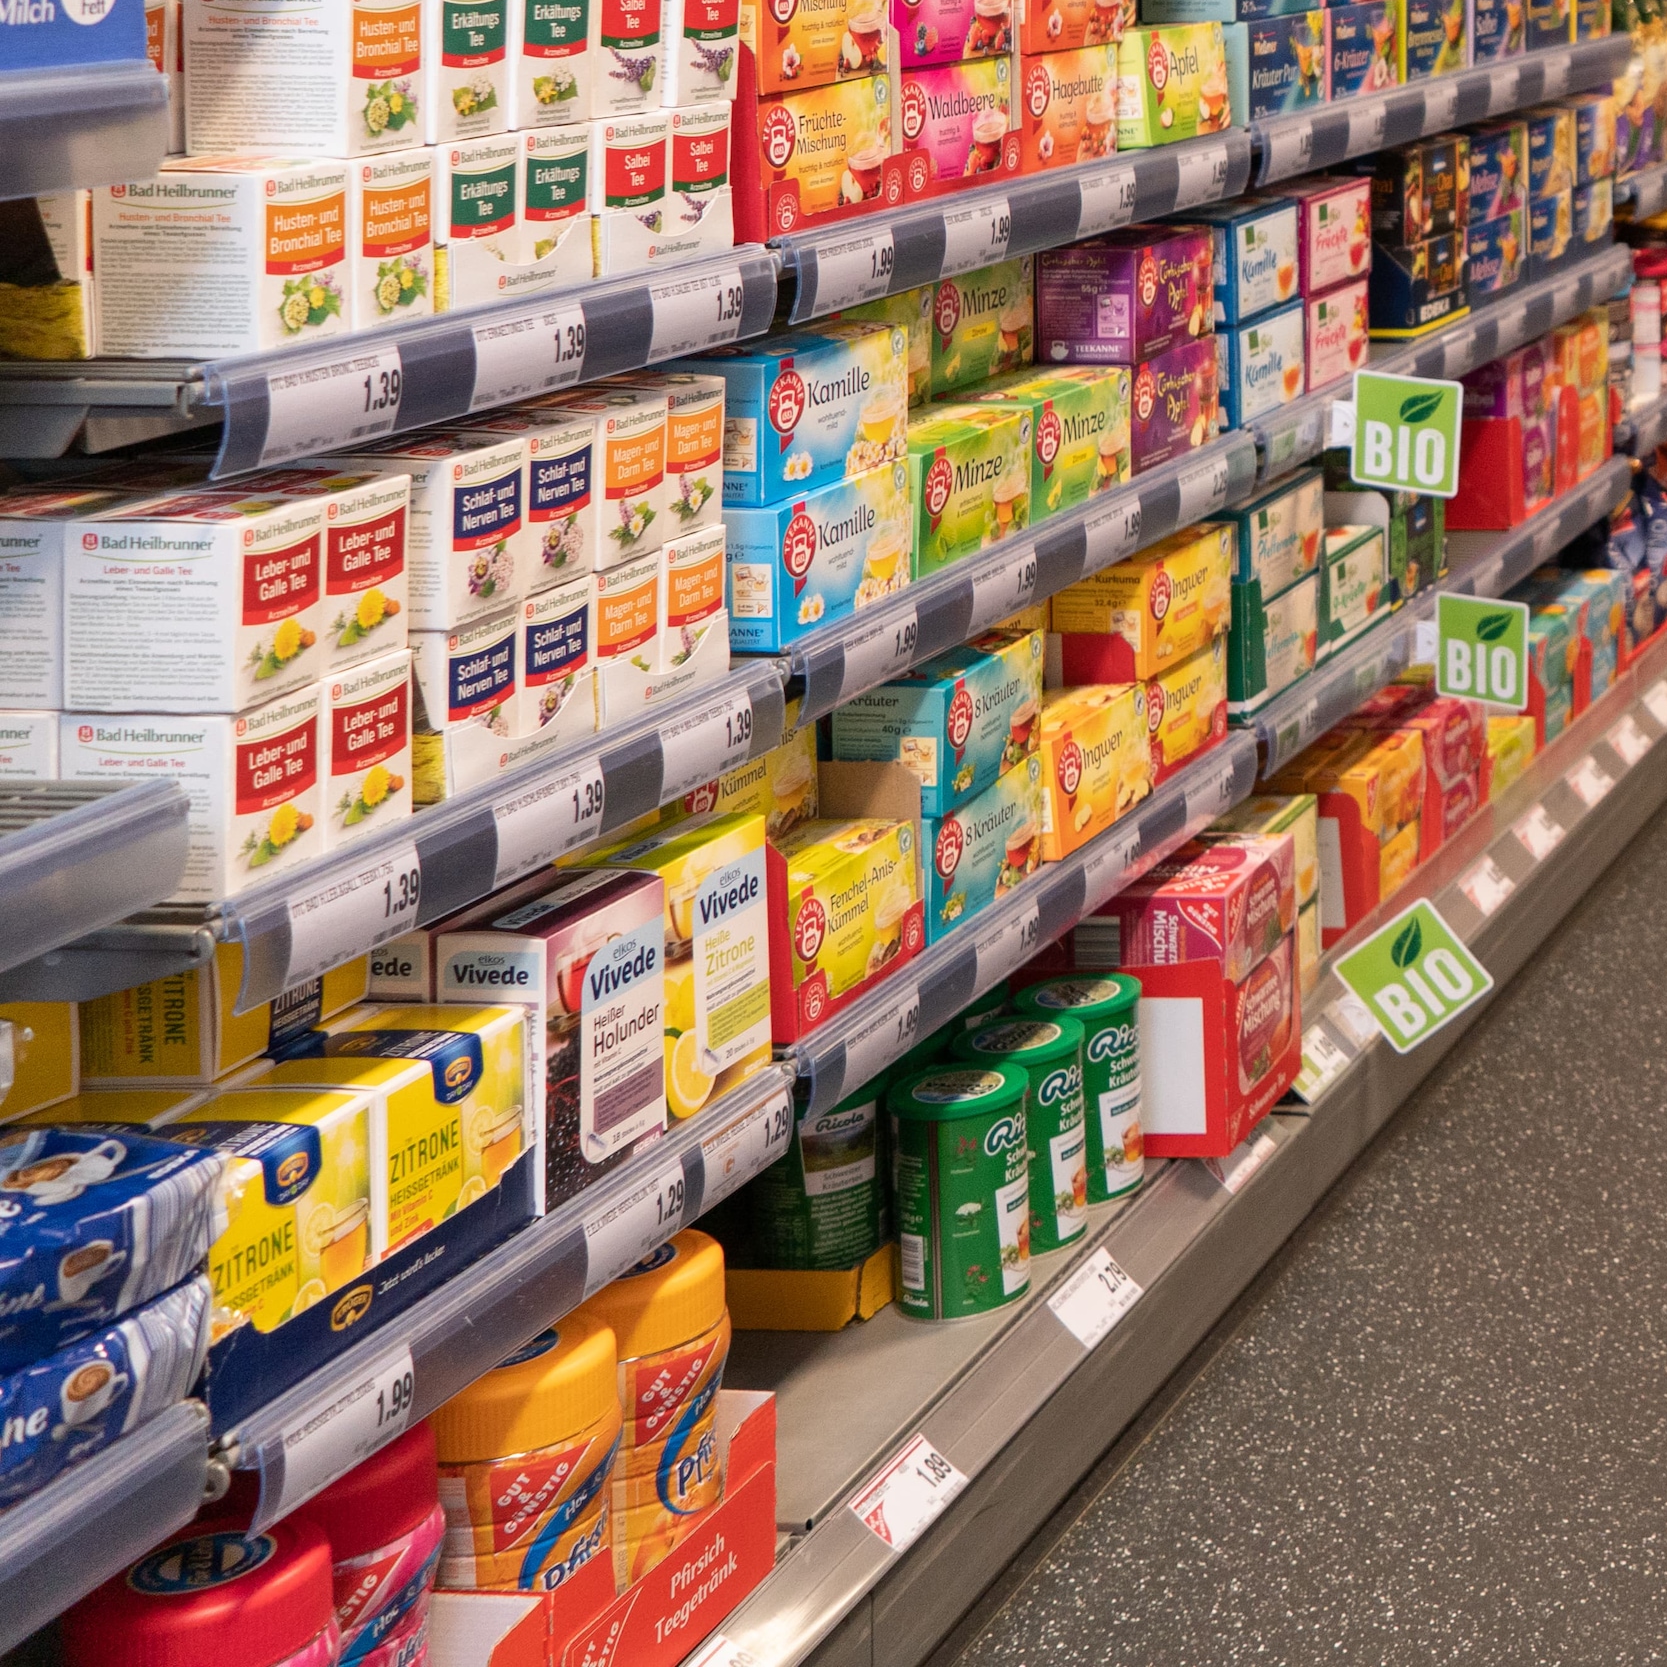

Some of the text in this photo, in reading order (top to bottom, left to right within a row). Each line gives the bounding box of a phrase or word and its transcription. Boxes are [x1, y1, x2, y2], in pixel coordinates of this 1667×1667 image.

[451, 8, 500, 29] Erkältungs
[625, 12, 640, 28] Tee
[468, 29, 485, 48] Tee
[1169, 51, 1200, 80] Apfel
[275, 207, 338, 233] Husten- und
[271, 226, 342, 254] Bronchial Tee
[871, 248, 894, 280] 1.99
[716, 285, 742, 320] 1.39
[808, 368, 870, 407] Kamille
[953, 454, 1002, 496] Minze
[1365, 433, 1445, 485] BIO
[102, 535, 212, 552] Bad Heilbrunner
[255, 549, 311, 581] Leber- und
[259, 572, 306, 601] Galle Tee
[1445, 641, 1519, 697] BIO
[1081, 729, 1123, 772] Ingwer
[382, 871, 419, 917] 1.39
[699, 876, 759, 923] Vivede
[828, 901, 871, 934] Kümmel
[590, 947, 655, 999] Vivede
[704, 937, 756, 974] Zitrone
[1375, 962, 1473, 1035] BIO
[593, 1006, 628, 1030] Heißer
[593, 1002, 661, 1055] Holunder
[389, 1123, 461, 1181] ZITRONE
[375, 1371, 413, 1428] 1.99
[670, 1534, 726, 1599] Pfirsich
[654, 1554, 738, 1643] Teegetränk
